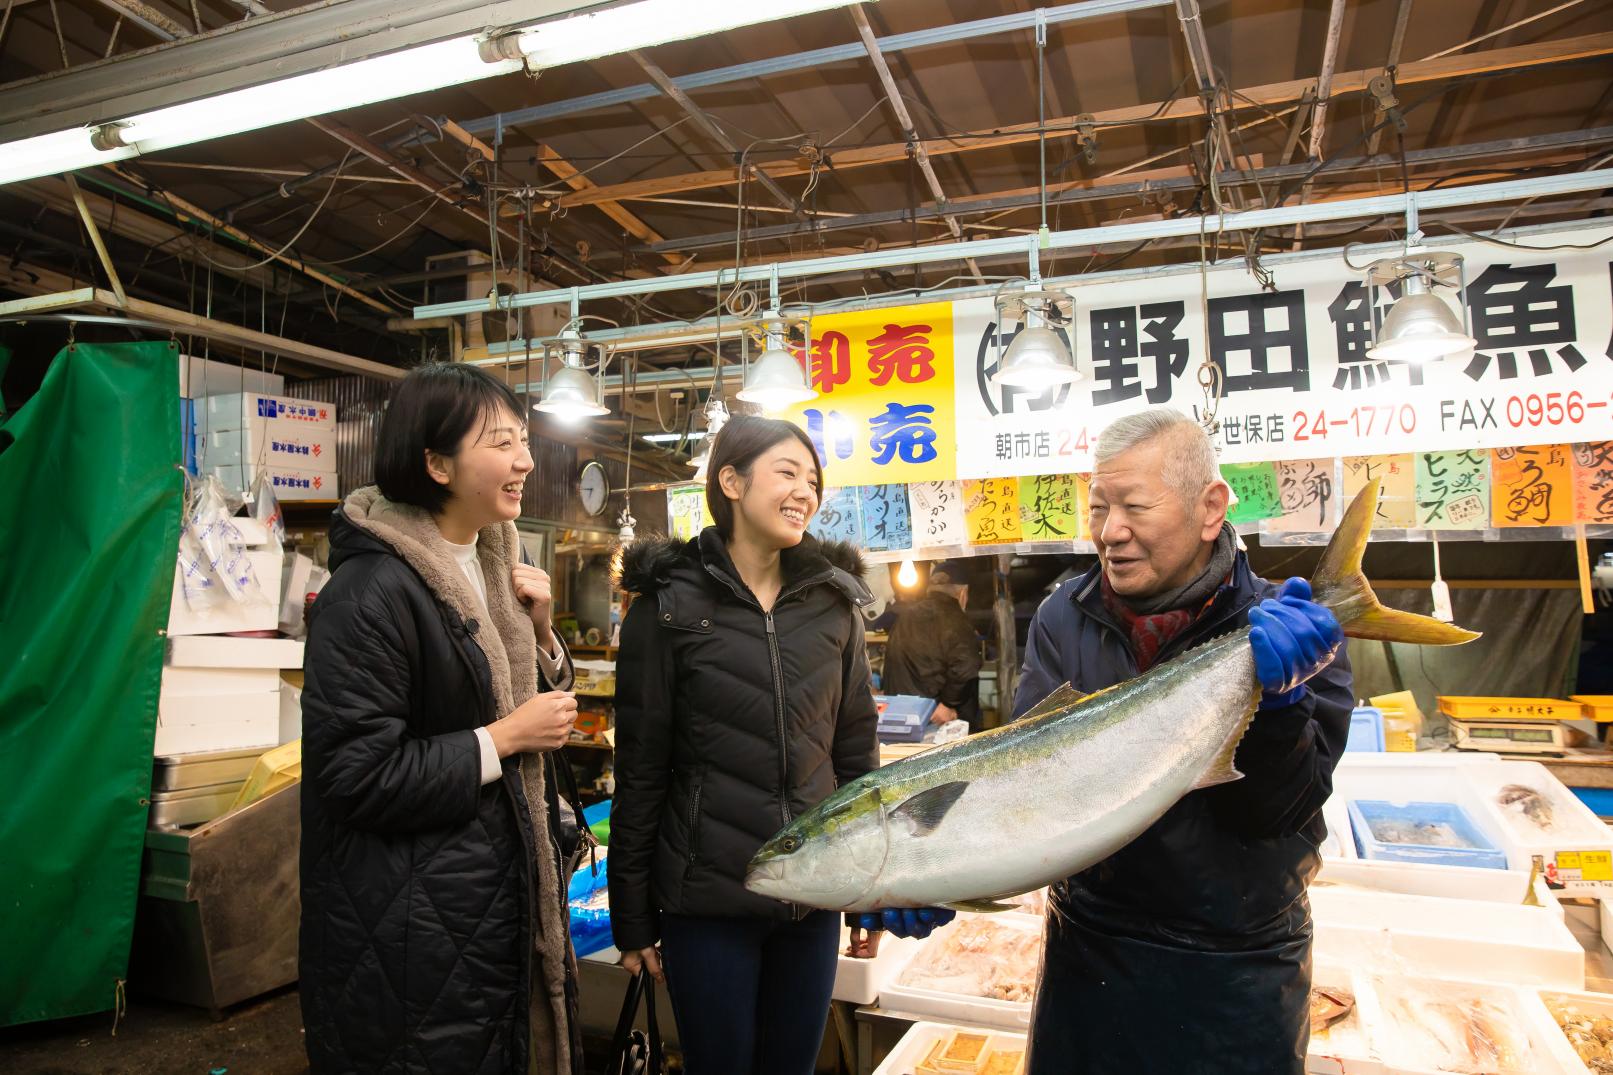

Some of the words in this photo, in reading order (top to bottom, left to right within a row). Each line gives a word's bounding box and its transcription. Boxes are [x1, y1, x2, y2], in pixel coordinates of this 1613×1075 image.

[994, 429, 1050, 466] 朝市店
[1057, 427, 1098, 461] 24-
[1214, 411, 1286, 448] 世保店
[1292, 404, 1417, 442] 24-1770
[1439, 397, 1498, 433] FAX
[1506, 390, 1613, 430] 0956-
[1001, 476, 1018, 533] 島直送
[1417, 452, 1449, 525] ヒラス
